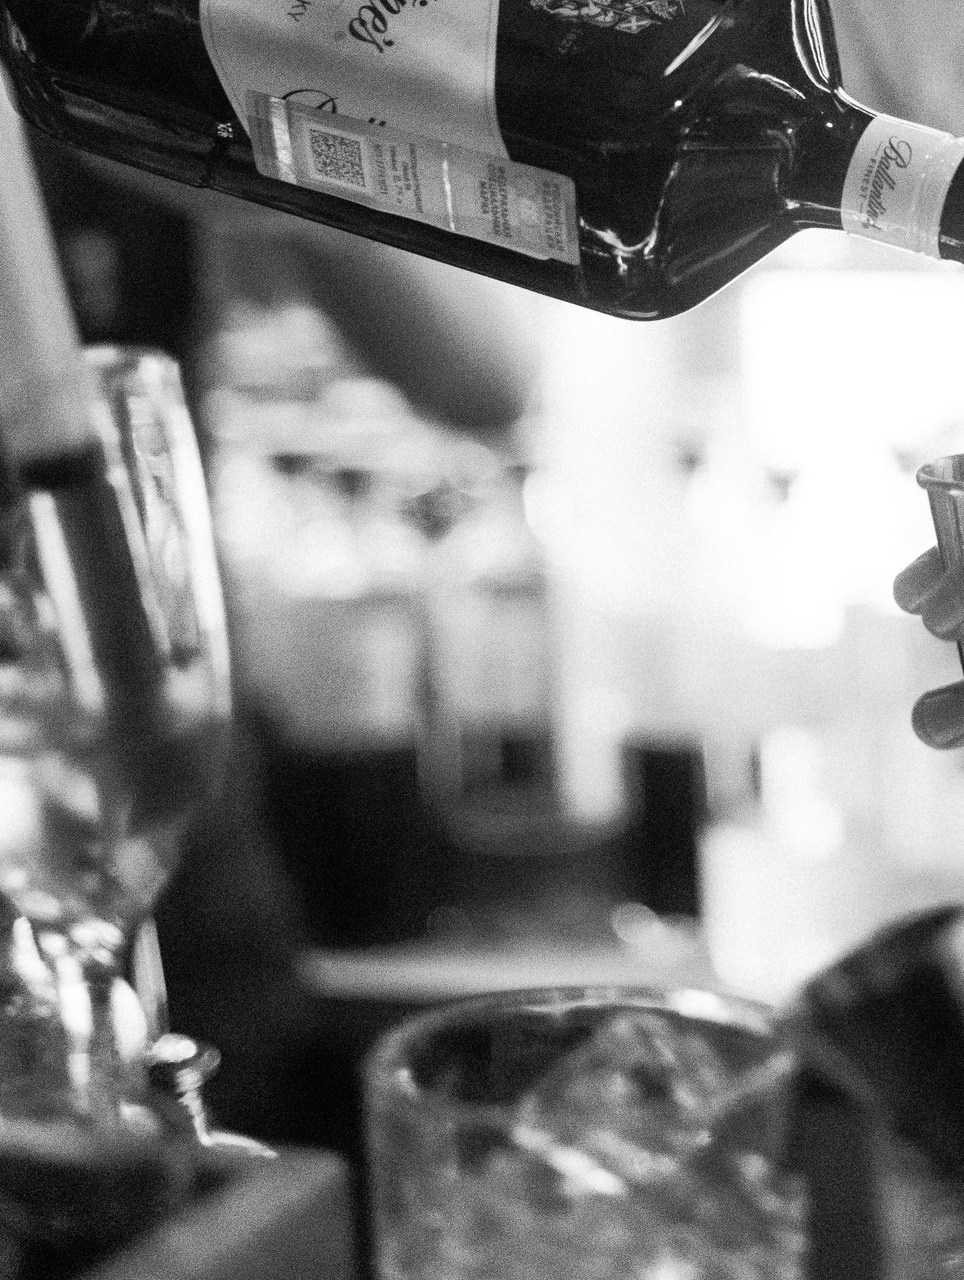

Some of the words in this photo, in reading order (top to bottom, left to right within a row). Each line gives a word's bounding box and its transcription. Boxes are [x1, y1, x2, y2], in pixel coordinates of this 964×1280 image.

[478, 180, 488, 214] МАРКА
[859, 158, 876, 199] FINEST
[542, 180, 554, 249] ФЕДЕРАЦИЯ
